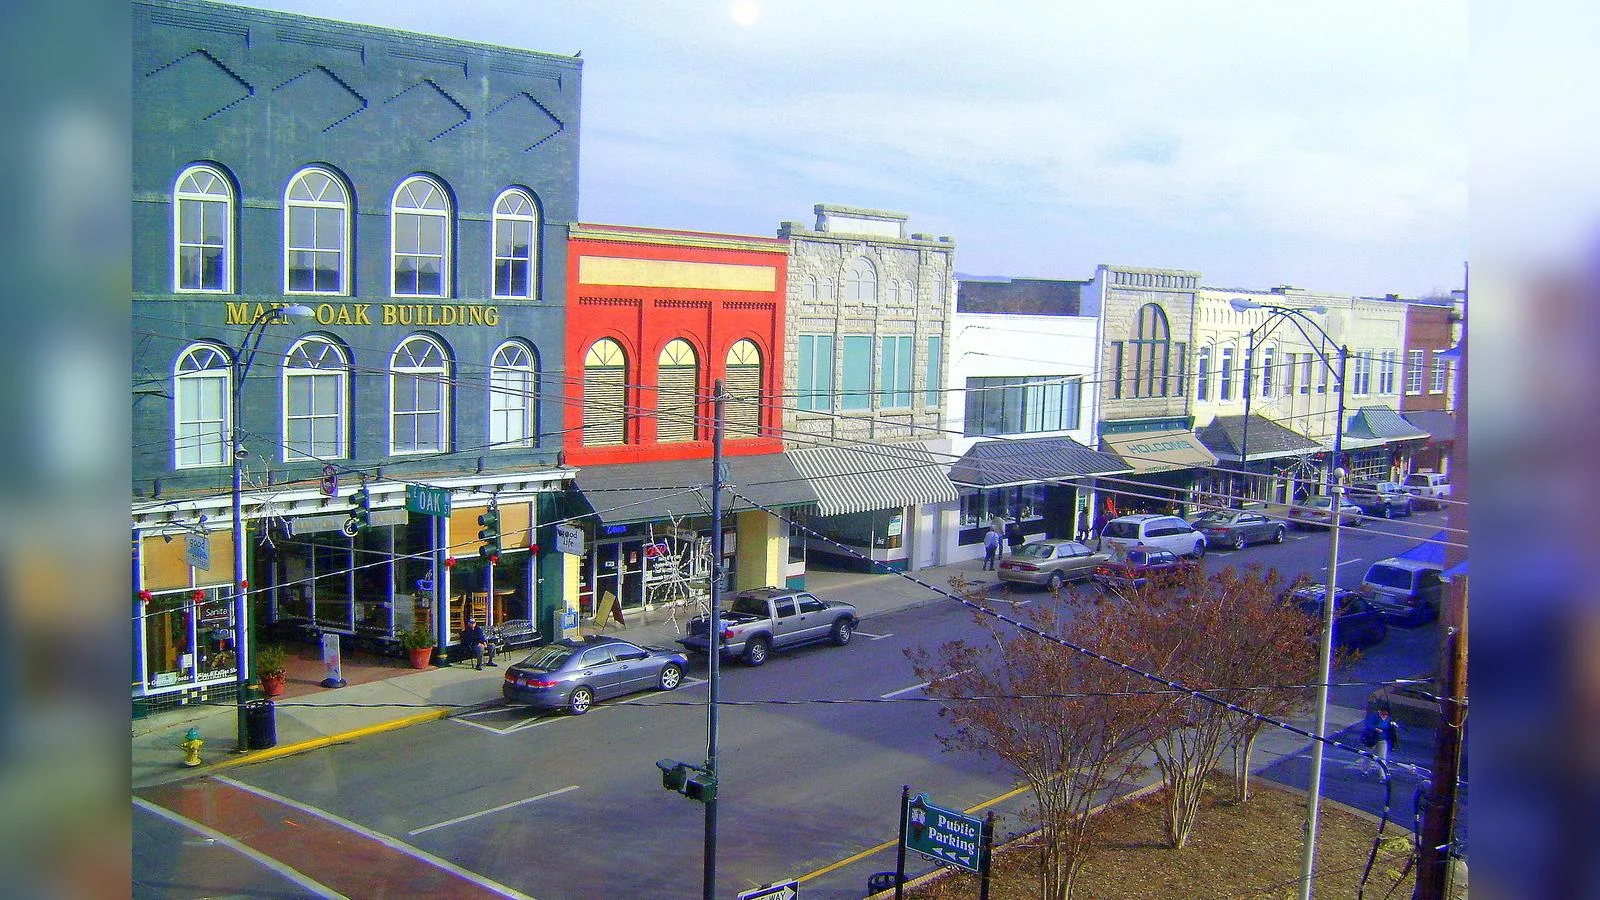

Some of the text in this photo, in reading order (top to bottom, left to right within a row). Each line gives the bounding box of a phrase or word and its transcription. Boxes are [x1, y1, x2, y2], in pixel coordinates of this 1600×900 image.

[315, 303, 371, 326] OAK
[382, 304, 500, 326] BUILDING
[419, 491, 441, 512] OAK
[938, 814, 975, 837] Public
[928, 826, 975, 855] Parking
